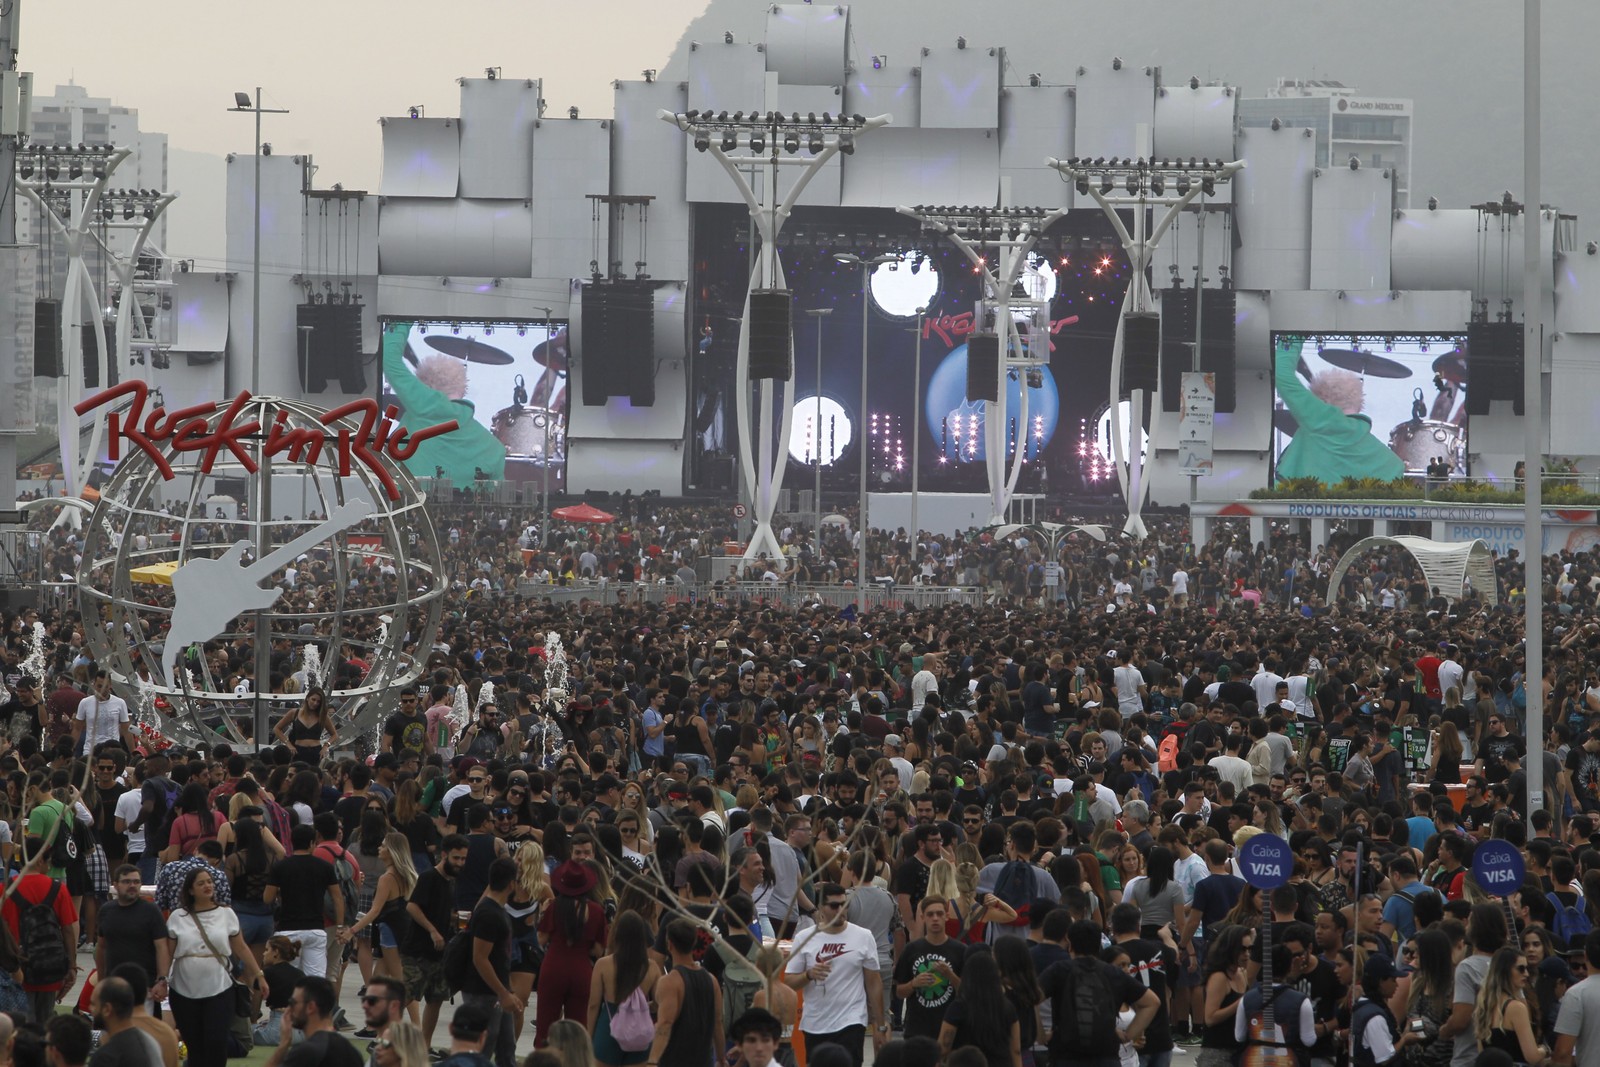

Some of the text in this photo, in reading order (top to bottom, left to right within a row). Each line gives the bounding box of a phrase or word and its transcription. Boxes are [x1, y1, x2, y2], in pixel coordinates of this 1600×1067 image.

[74, 379, 460, 501] Rock in Rio
[1289, 504, 1495, 521] PRODUTOS OFICIAIS ROCK IN RIO
[1251, 844, 1281, 858] Caixa
[1481, 852, 1511, 865] Caixa
[1249, 862, 1282, 877] VISA
[1483, 869, 1516, 883] VISA
[821, 943, 846, 954] NIKE
